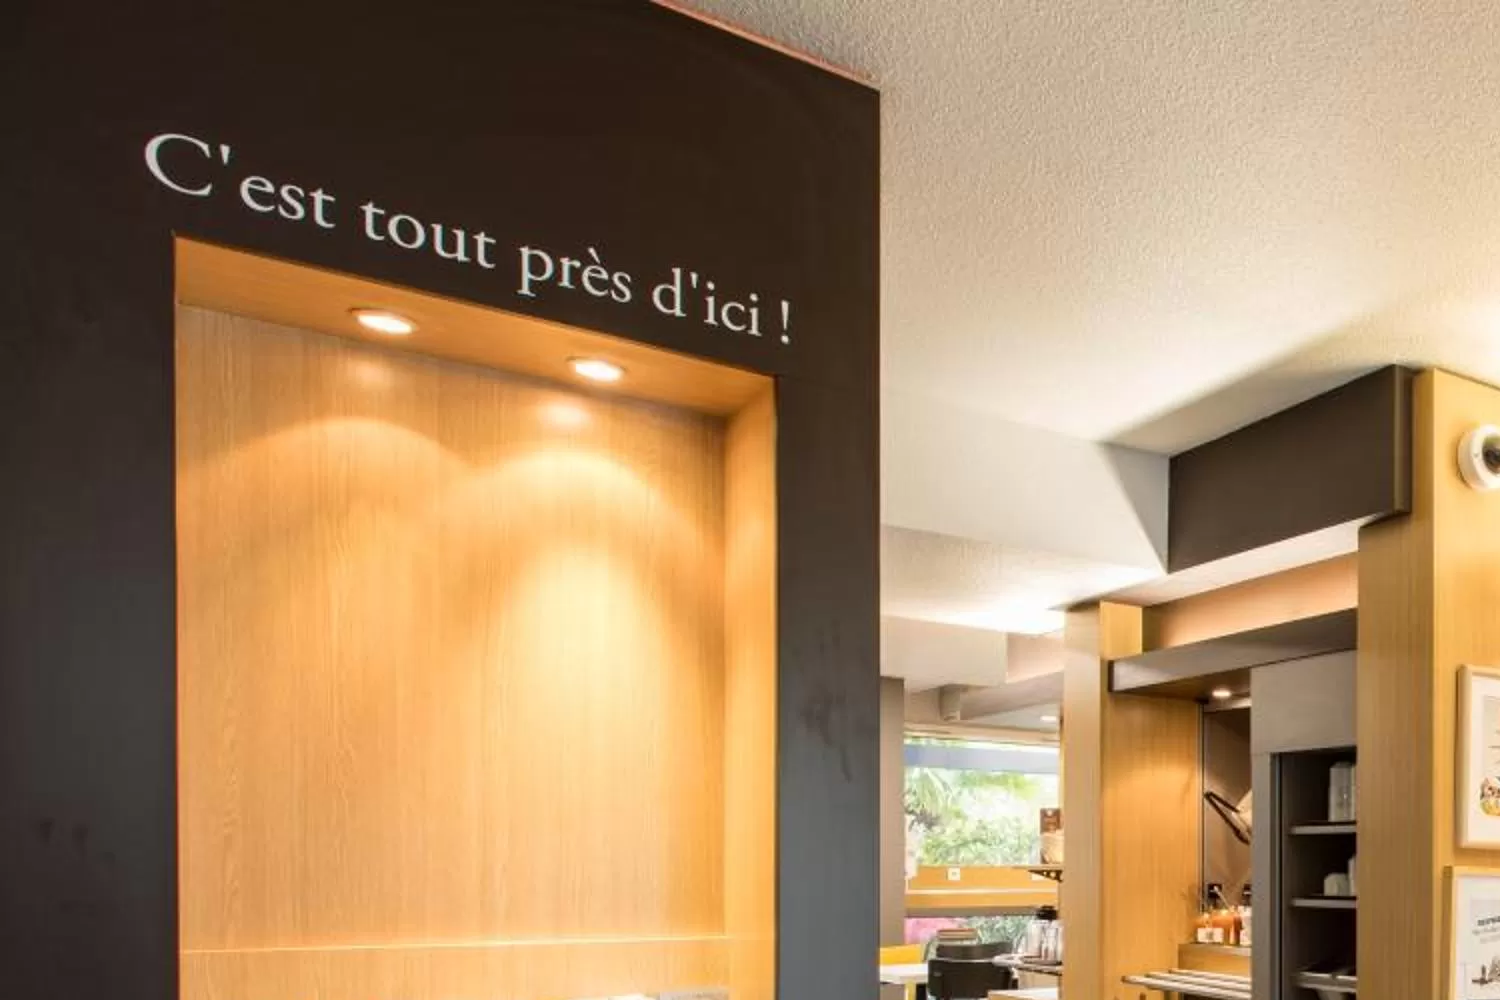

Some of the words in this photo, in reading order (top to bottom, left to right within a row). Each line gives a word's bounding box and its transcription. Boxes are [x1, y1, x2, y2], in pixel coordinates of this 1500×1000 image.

[144, 133, 336, 229] C'est
[360, 201, 497, 269] tout
[517, 246, 633, 303] près
[653, 268, 763, 337] d'ici
[779, 300, 792, 344] !
